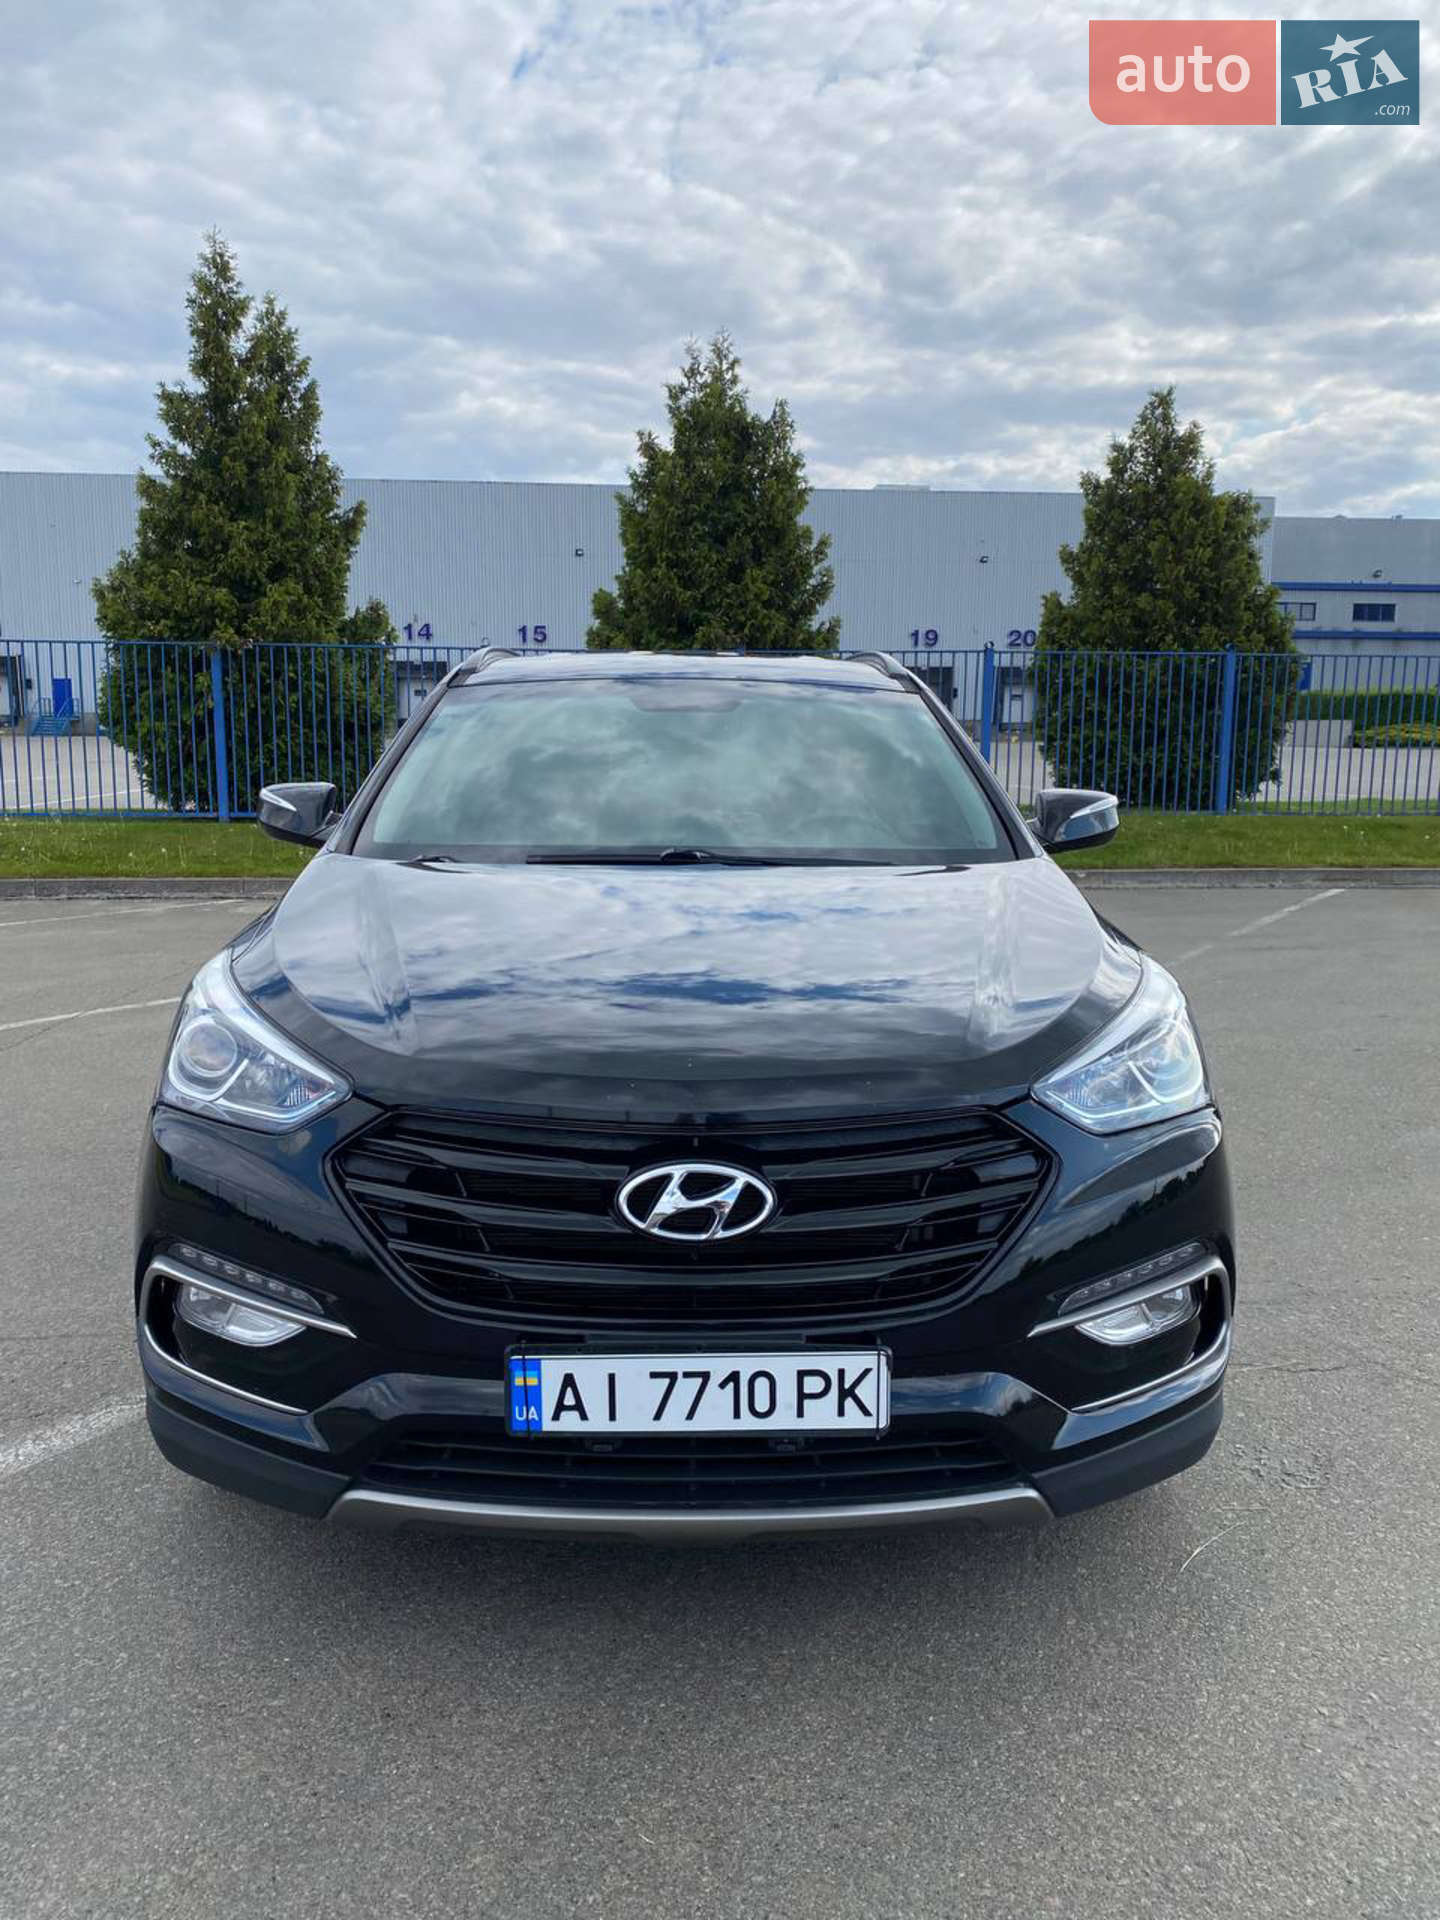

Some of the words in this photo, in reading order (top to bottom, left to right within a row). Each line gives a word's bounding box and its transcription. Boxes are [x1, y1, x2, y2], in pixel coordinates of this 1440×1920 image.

[403, 623, 433, 641] 14
[518, 625, 547, 643] 15
[911, 629, 939, 647] 19
[1008, 629, 1037, 647] 20
[649, 1370, 777, 1421] 7710
[796, 1368, 874, 1419] PK
[515, 1405, 539, 1421] UA
